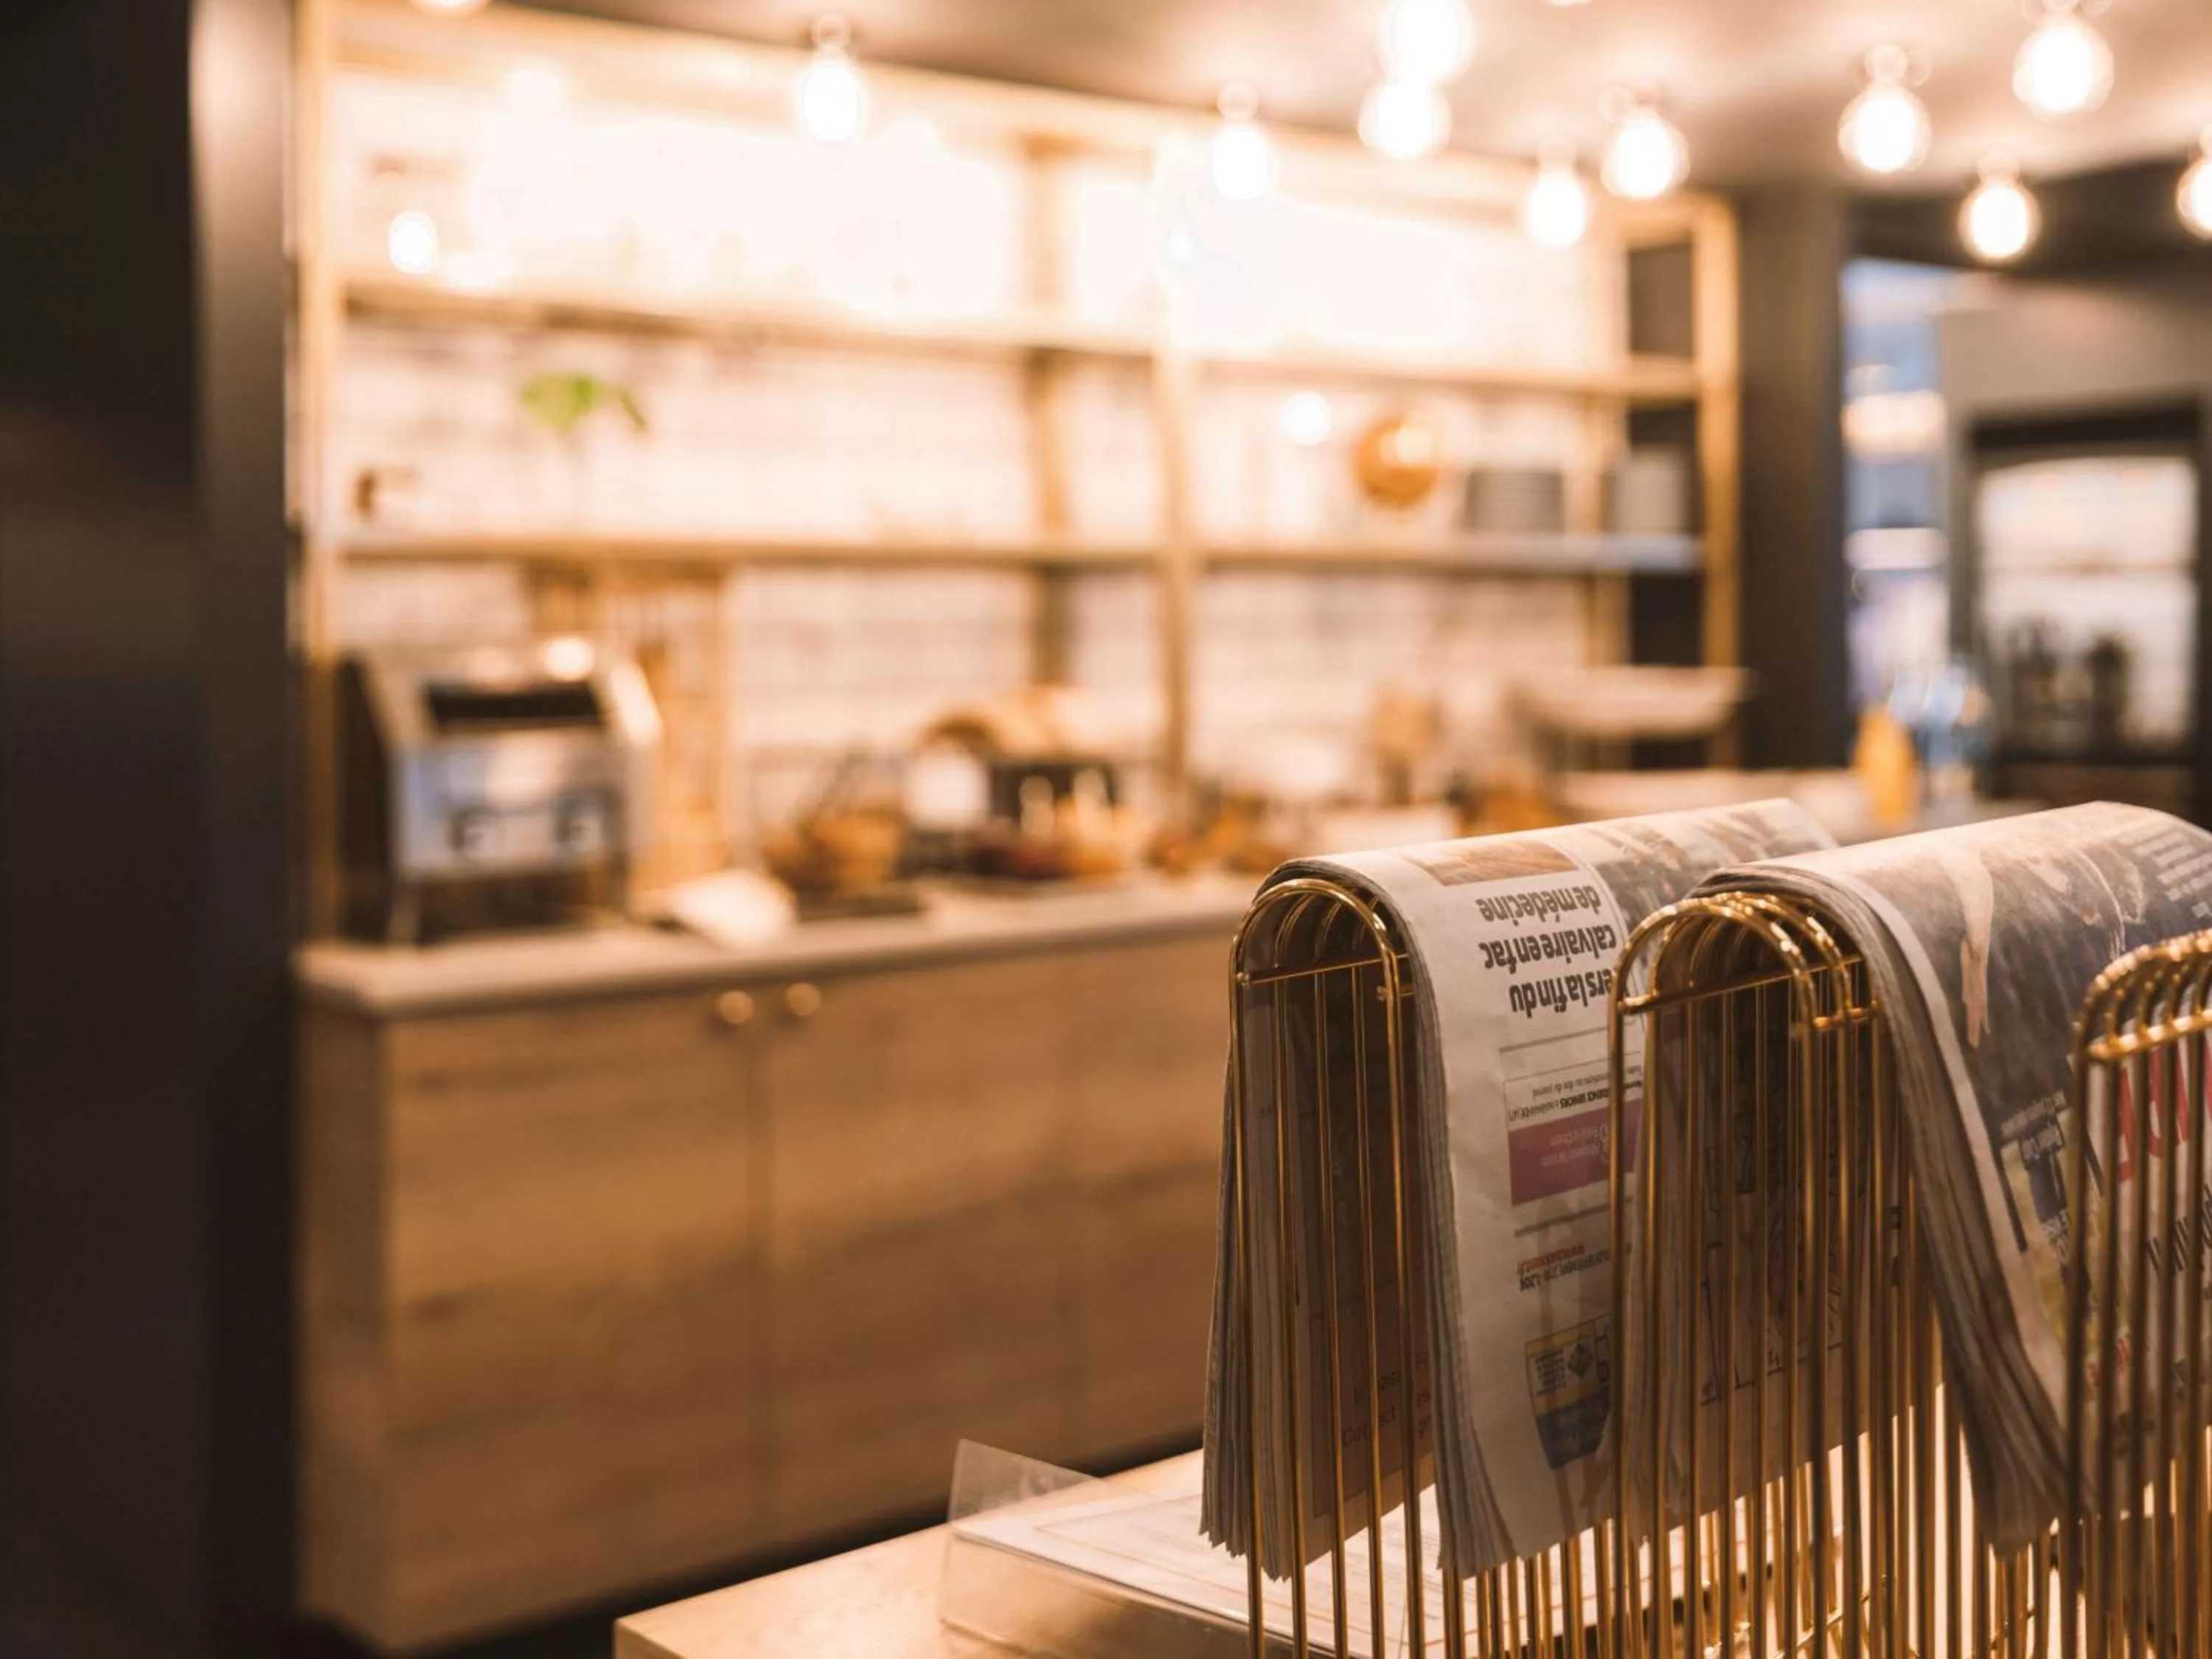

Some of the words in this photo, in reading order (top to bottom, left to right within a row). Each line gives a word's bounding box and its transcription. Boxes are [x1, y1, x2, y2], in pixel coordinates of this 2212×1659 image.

[1475, 888, 1578, 926] médecine
[1574, 886, 1601, 914] de
[1478, 939, 1517, 974] fac
[1514, 935, 1542, 961] en
[1540, 925, 1617, 964] calvaire
[1509, 982, 1537, 1018] du
[1585, 969, 1613, 998] ers
